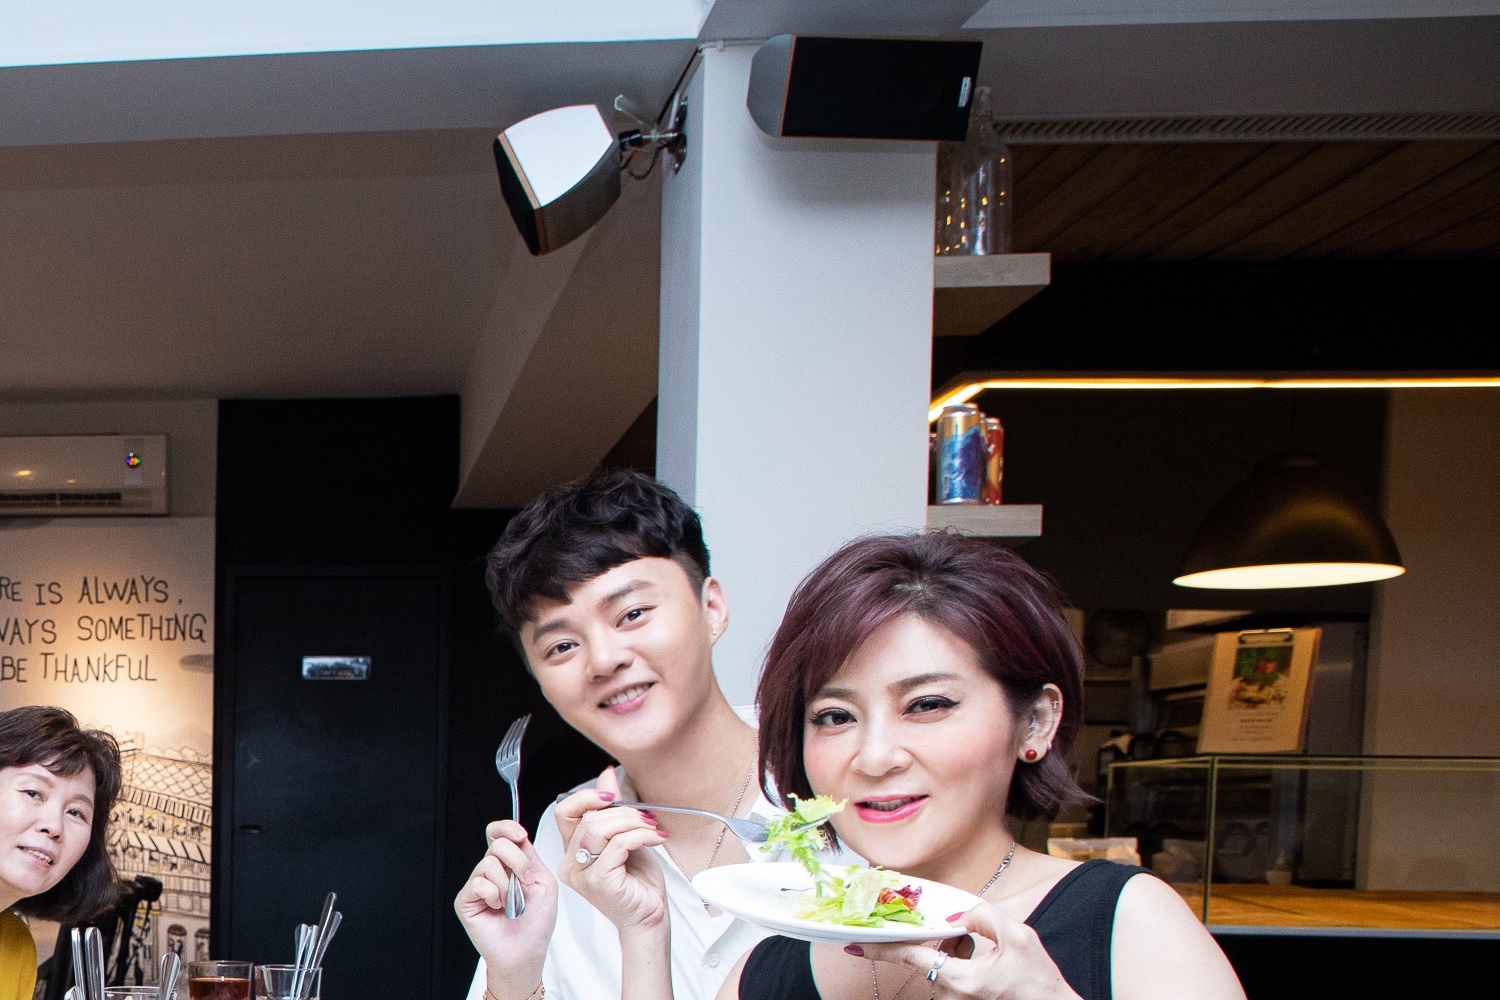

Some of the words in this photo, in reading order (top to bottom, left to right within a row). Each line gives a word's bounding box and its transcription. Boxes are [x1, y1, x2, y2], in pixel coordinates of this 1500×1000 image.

[33, 582, 64, 606] IS
[77, 612, 207, 643] SOMETHING
[0, 655, 28, 683] BE
[40, 652, 158, 683] THANKFUL
